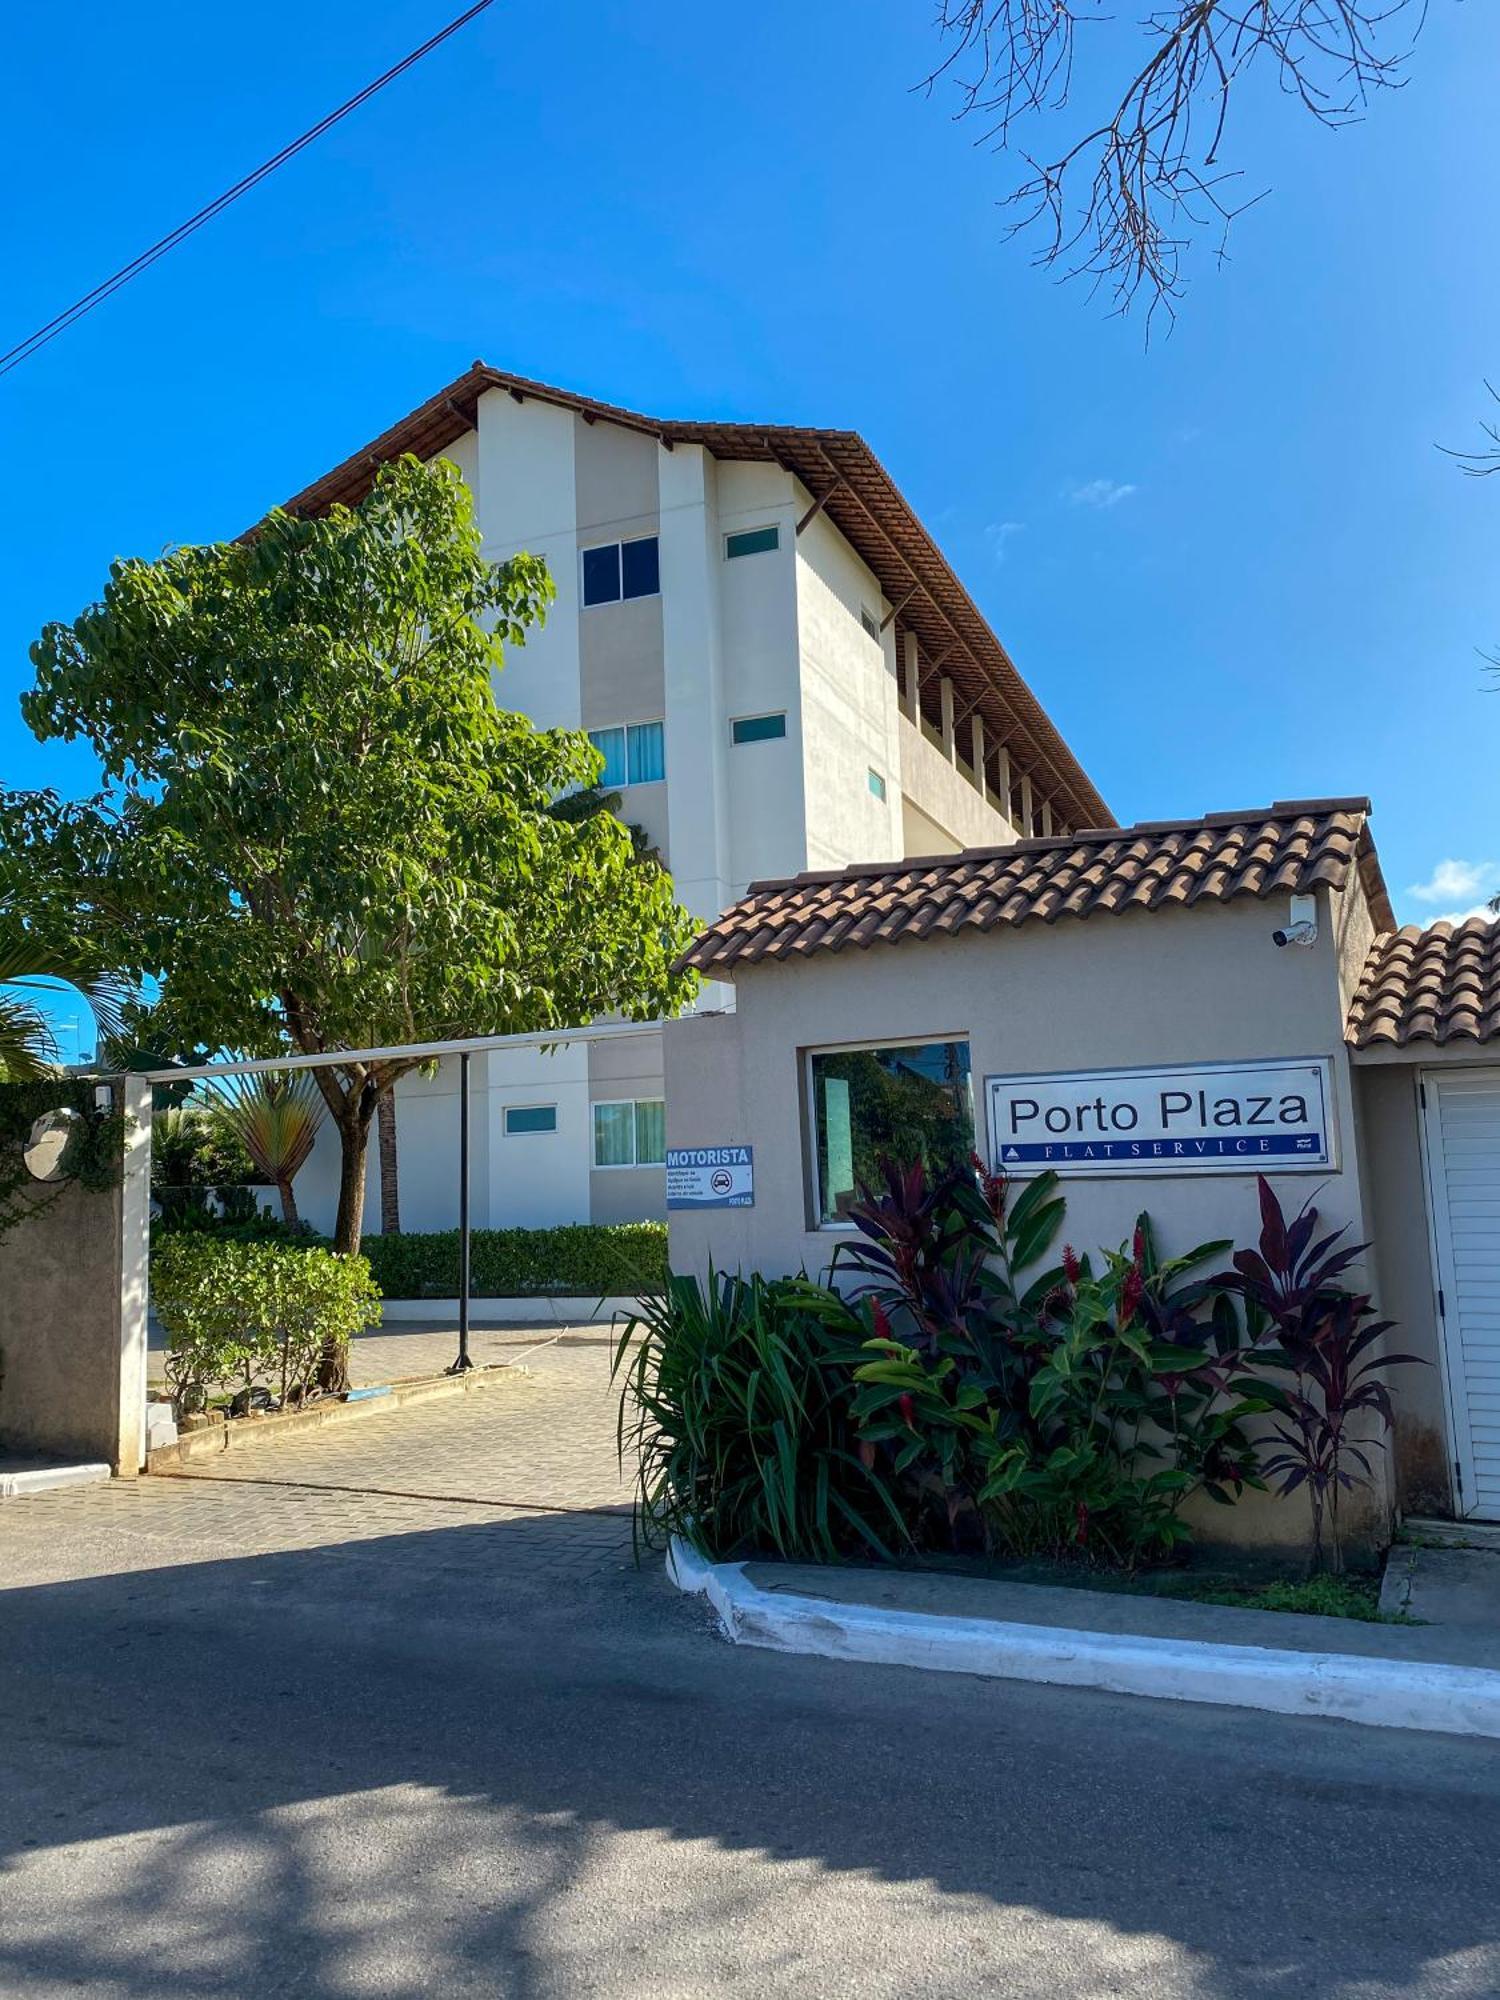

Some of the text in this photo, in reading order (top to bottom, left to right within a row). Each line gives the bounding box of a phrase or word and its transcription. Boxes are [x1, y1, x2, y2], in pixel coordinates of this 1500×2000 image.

[1010, 1090, 1308, 1134] Porto Plaza
[667, 1149, 748, 1166] MOTORISTA
[1045, 1139, 1271, 1158] FLAT SERVICE
